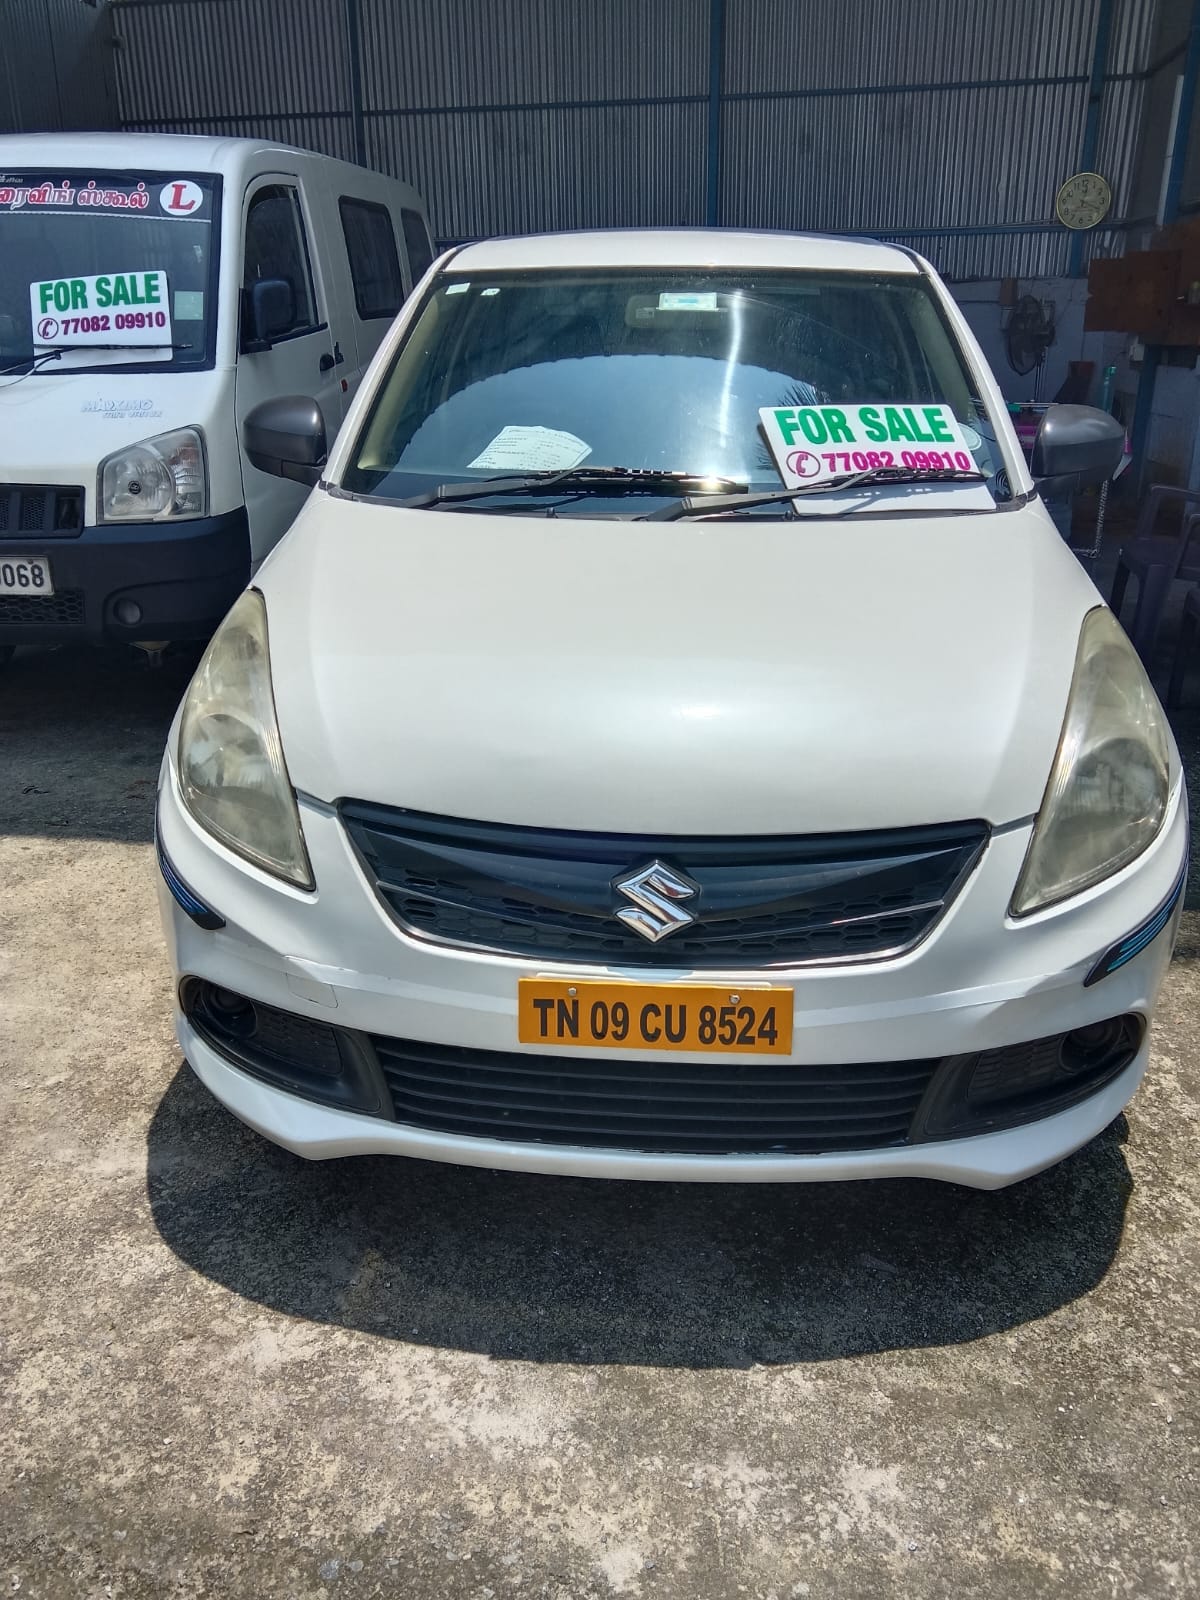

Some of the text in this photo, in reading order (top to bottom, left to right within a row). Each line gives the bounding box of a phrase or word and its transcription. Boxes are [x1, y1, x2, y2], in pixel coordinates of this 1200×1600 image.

[77, 181, 150, 209] ஸ்கூல்
[168, 184, 196, 210] L
[39, 273, 161, 314] FOR SALE
[61, 311, 166, 335] 77082 09910
[774, 407, 955, 446] FOR SALE
[821, 451, 971, 473] 77082 09910
[0, 563, 44, 588] 068
[533, 998, 778, 1046] TN 09 CU 8524
